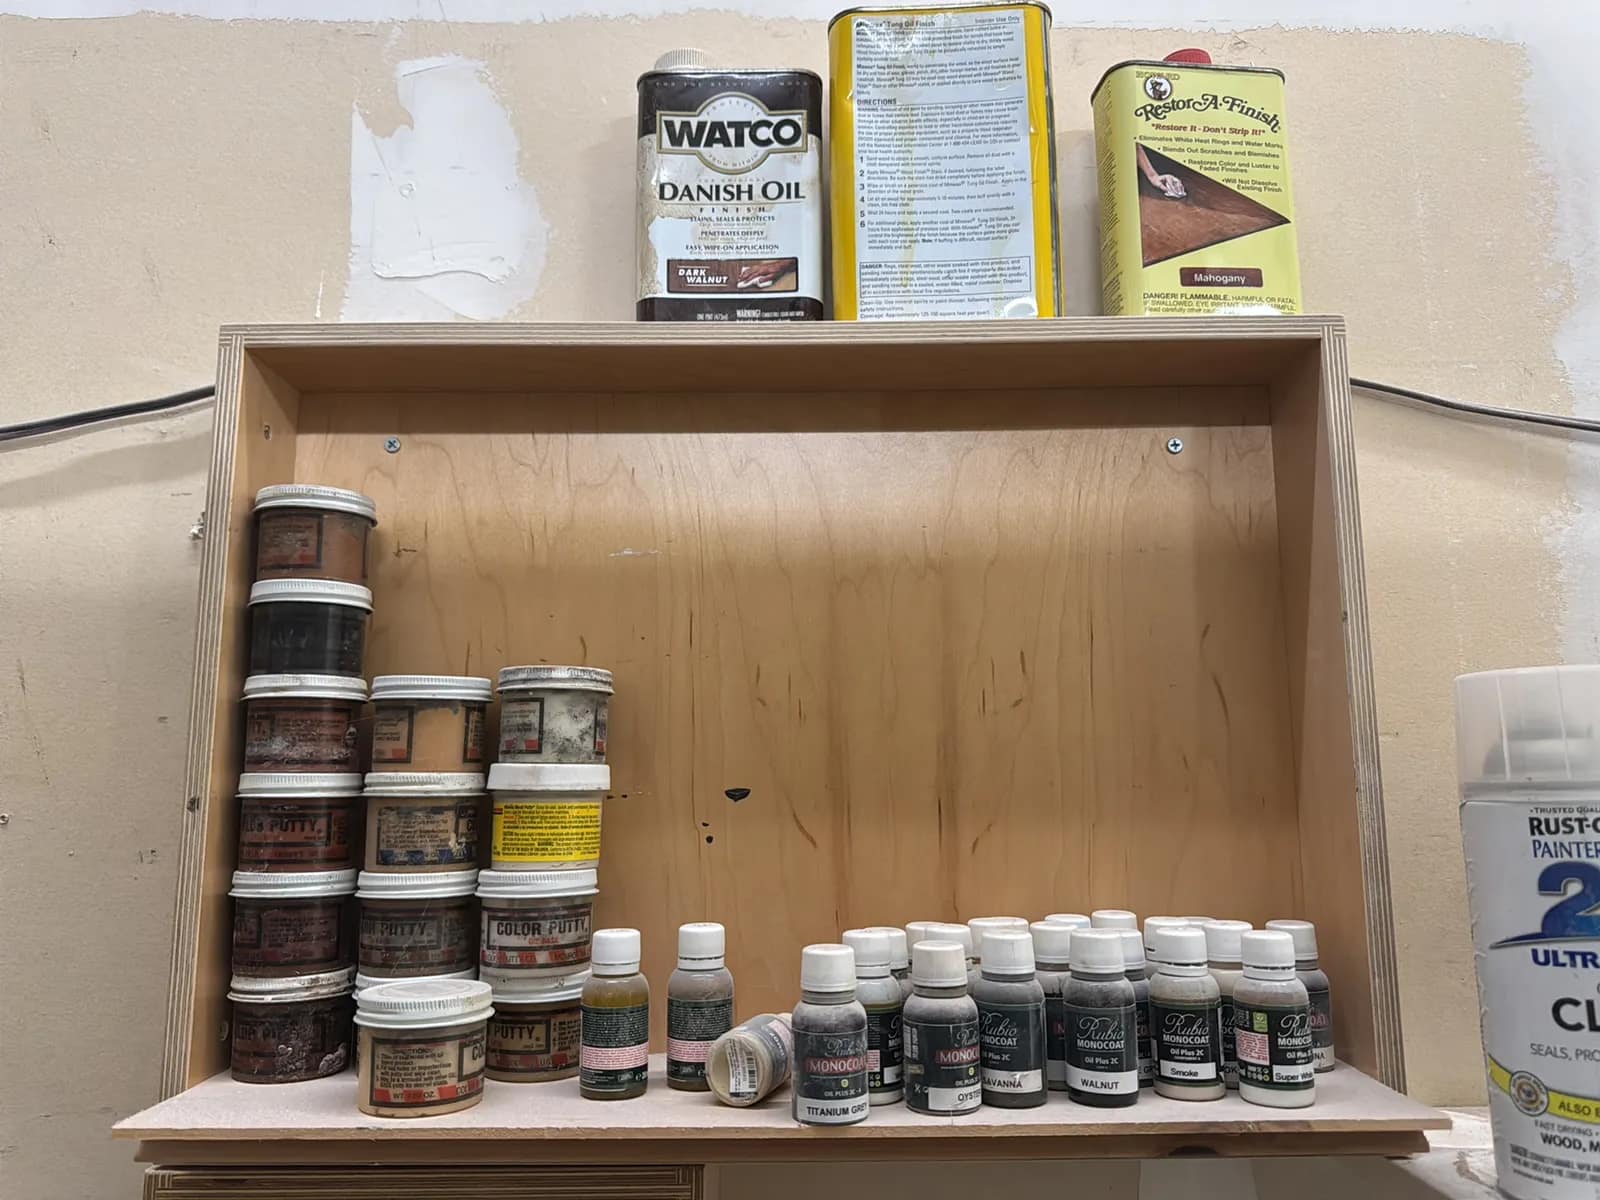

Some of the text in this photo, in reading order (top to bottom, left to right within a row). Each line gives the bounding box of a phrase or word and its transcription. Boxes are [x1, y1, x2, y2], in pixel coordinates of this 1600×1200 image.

[856, 98, 897, 106] DIRECTIONS
[663, 119, 802, 148] WATCO
[1203, 125, 1227, 134] Don't
[1228, 126, 1250, 137] Strip
[1211, 138, 1230, 146] Rings
[1245, 140, 1264, 148] Water
[1200, 148, 1233, 156] Scratches
[1248, 151, 1280, 159] Blemishes
[1188, 158, 1218, 166] Restores
[1250, 162, 1271, 170] Luster
[658, 180, 807, 202] DANISH OIL
[1236, 184, 1283, 193] Existing Finish
[741, 215, 775, 223] PROTECTS
[735, 243, 780, 251] APPLICATION
[678, 268, 707, 276] DARK
[687, 276, 729, 284] WALNUT
[1194, 273, 1246, 284] Mahogany
[1143, 292, 1178, 300] DANGER!
[496, 922, 541, 936] COLOR
[1077, 1016, 1125, 1040] Rubio
[1162, 1012, 1209, 1035] Rubio
[494, 1025, 535, 1040] PUTTY
[1077, 1039, 1125, 1050] MONOCOAT
[1163, 1034, 1209, 1044] MONOCOAT
[1170, 1068, 1199, 1077] Smoke
[1275, 1071, 1299, 1081] Super
[1081, 1078, 1120, 1089] WALNUT
[807, 1106, 850, 1116] TITANIUM
[1558, 1101, 1591, 1116] ALSO
[1540, 1132, 1586, 1153] WOOD,
